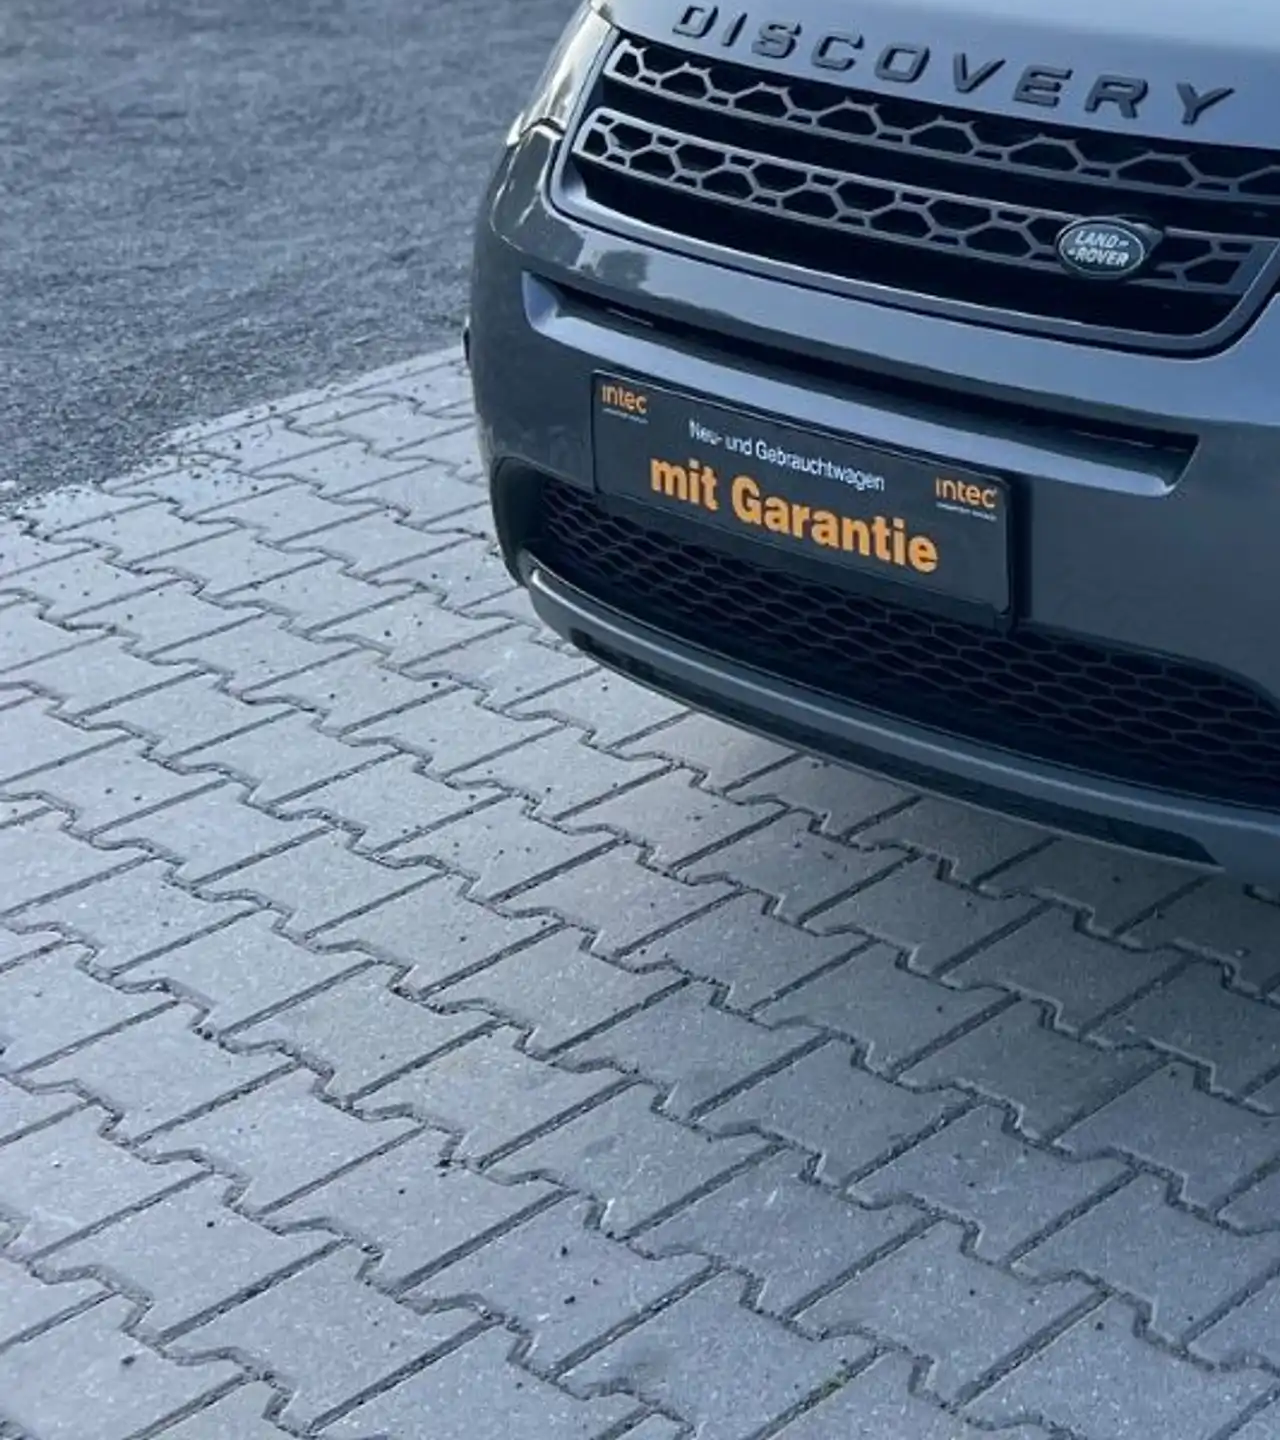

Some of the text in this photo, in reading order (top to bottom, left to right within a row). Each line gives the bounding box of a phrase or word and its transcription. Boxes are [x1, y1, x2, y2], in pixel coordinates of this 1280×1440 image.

[672, 4, 1236, 126] DISCOVERY
[725, 435, 753, 456] und
[755, 439, 886, 492] Gebrauchtwagen
[934, 476, 998, 509] intec
[650, 457, 939, 574] mit Garantie
